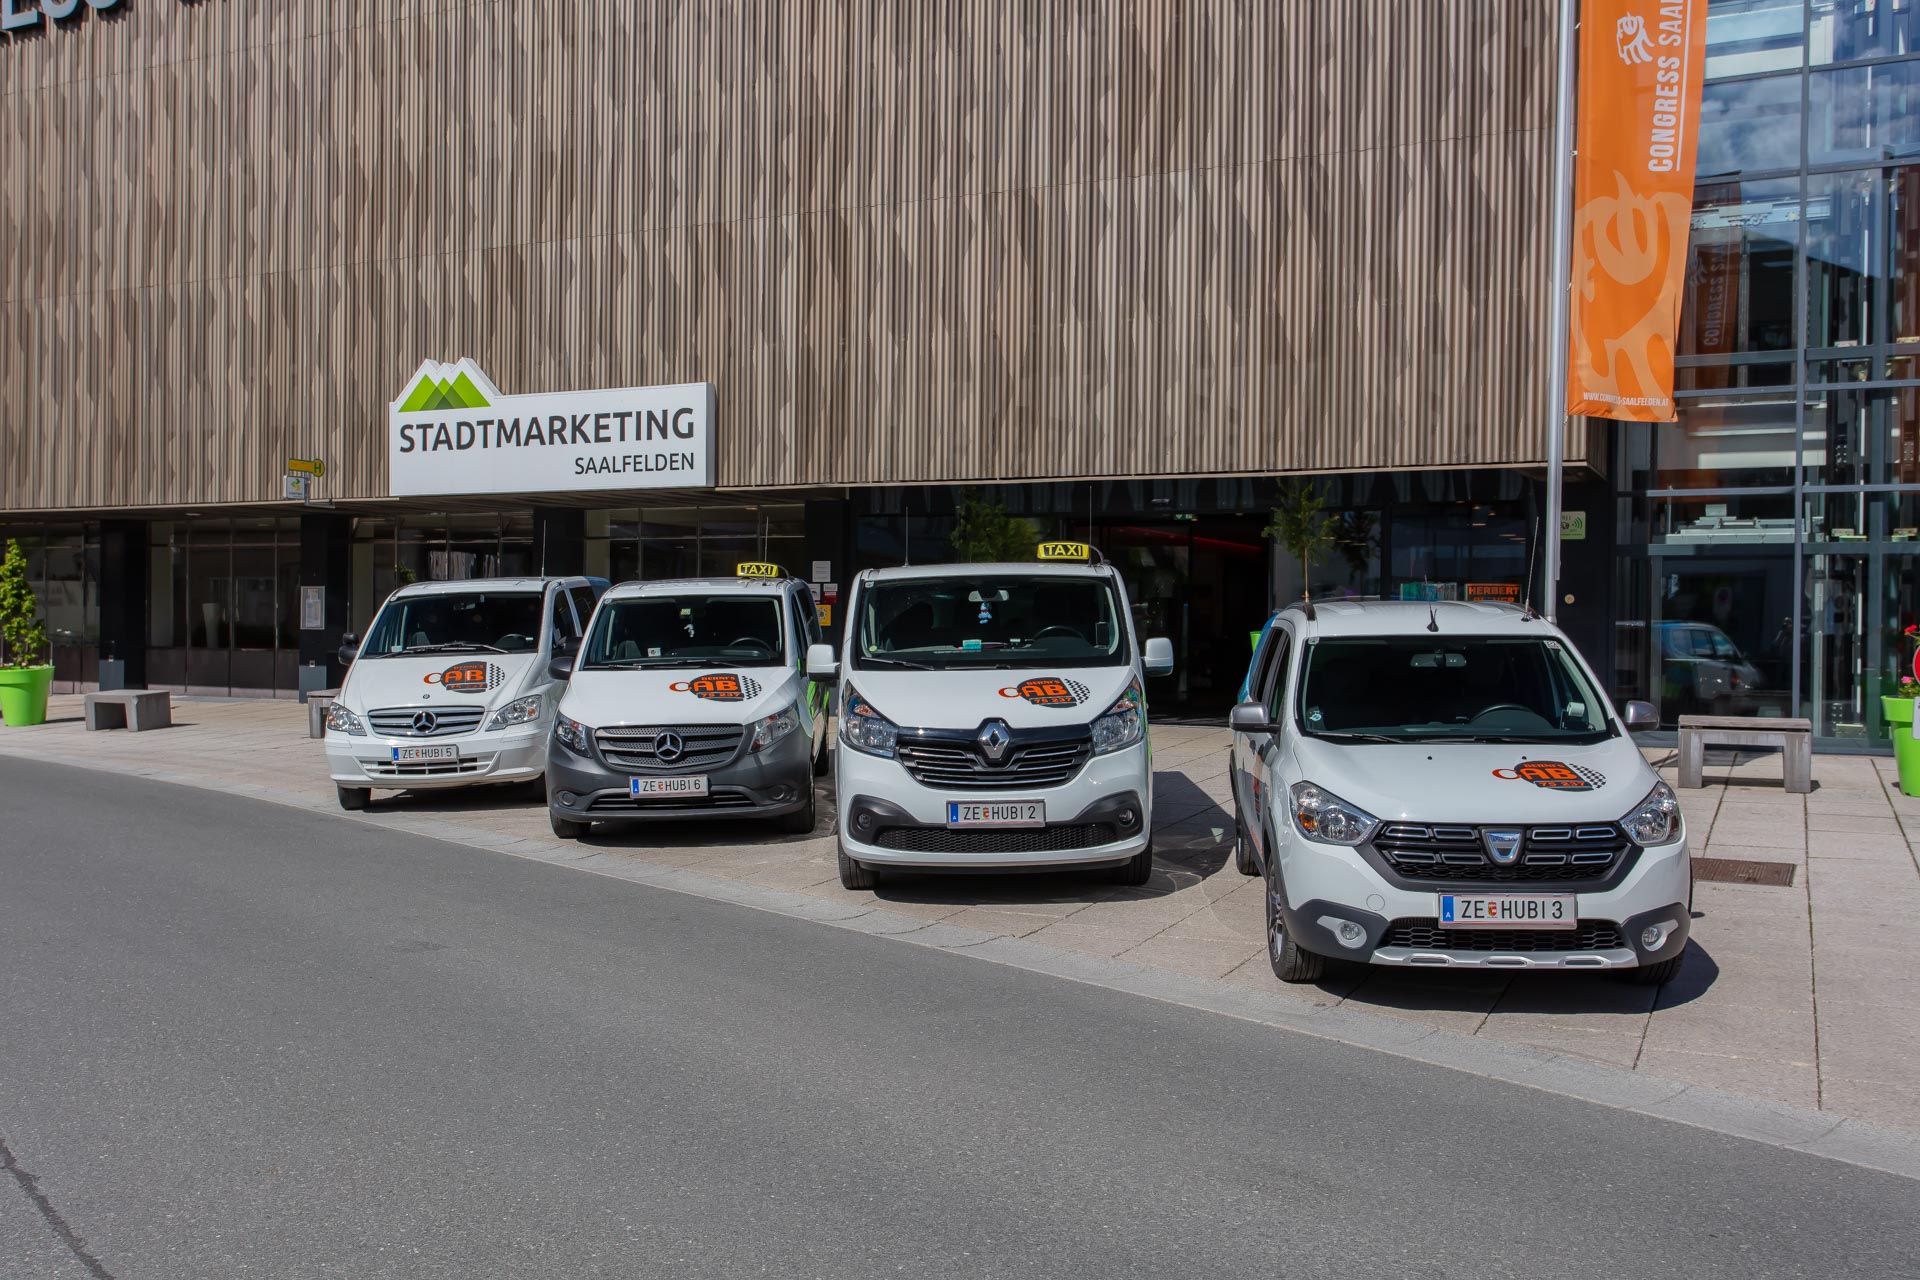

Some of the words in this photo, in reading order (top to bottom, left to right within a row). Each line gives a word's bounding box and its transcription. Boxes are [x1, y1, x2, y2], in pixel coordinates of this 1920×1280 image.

[1648, 55, 1680, 172] CONGRESS
[399, 407, 695, 453] STADTMARKETING
[314, 462, 322, 473] H
[574, 452, 695, 475] SAALFELDEN
[1045, 544, 1082, 556] TAXI
[743, 564, 772, 575] TAXI
[1468, 586, 1520, 595] HERBERT
[423, 669, 484, 685] CAB
[668, 680, 739, 692] CAB
[998, 684, 1068, 698] CAB
[402, 749, 414, 759] ZE
[421, 748, 443, 758] HUBI
[446, 747, 452, 757] 5
[1491, 767, 1578, 780] CAB
[642, 780, 657, 792] ZE
[665, 780, 691, 791] HUBI
[694, 779, 701, 790] 6
[963, 806, 981, 820] ZE
[991, 806, 1023, 820] HUBI
[1028, 805, 1036, 819] 2
[1461, 900, 1485, 919] ZE
[1501, 900, 1545, 919] HUBI
[1552, 900, 1563, 919] 3
